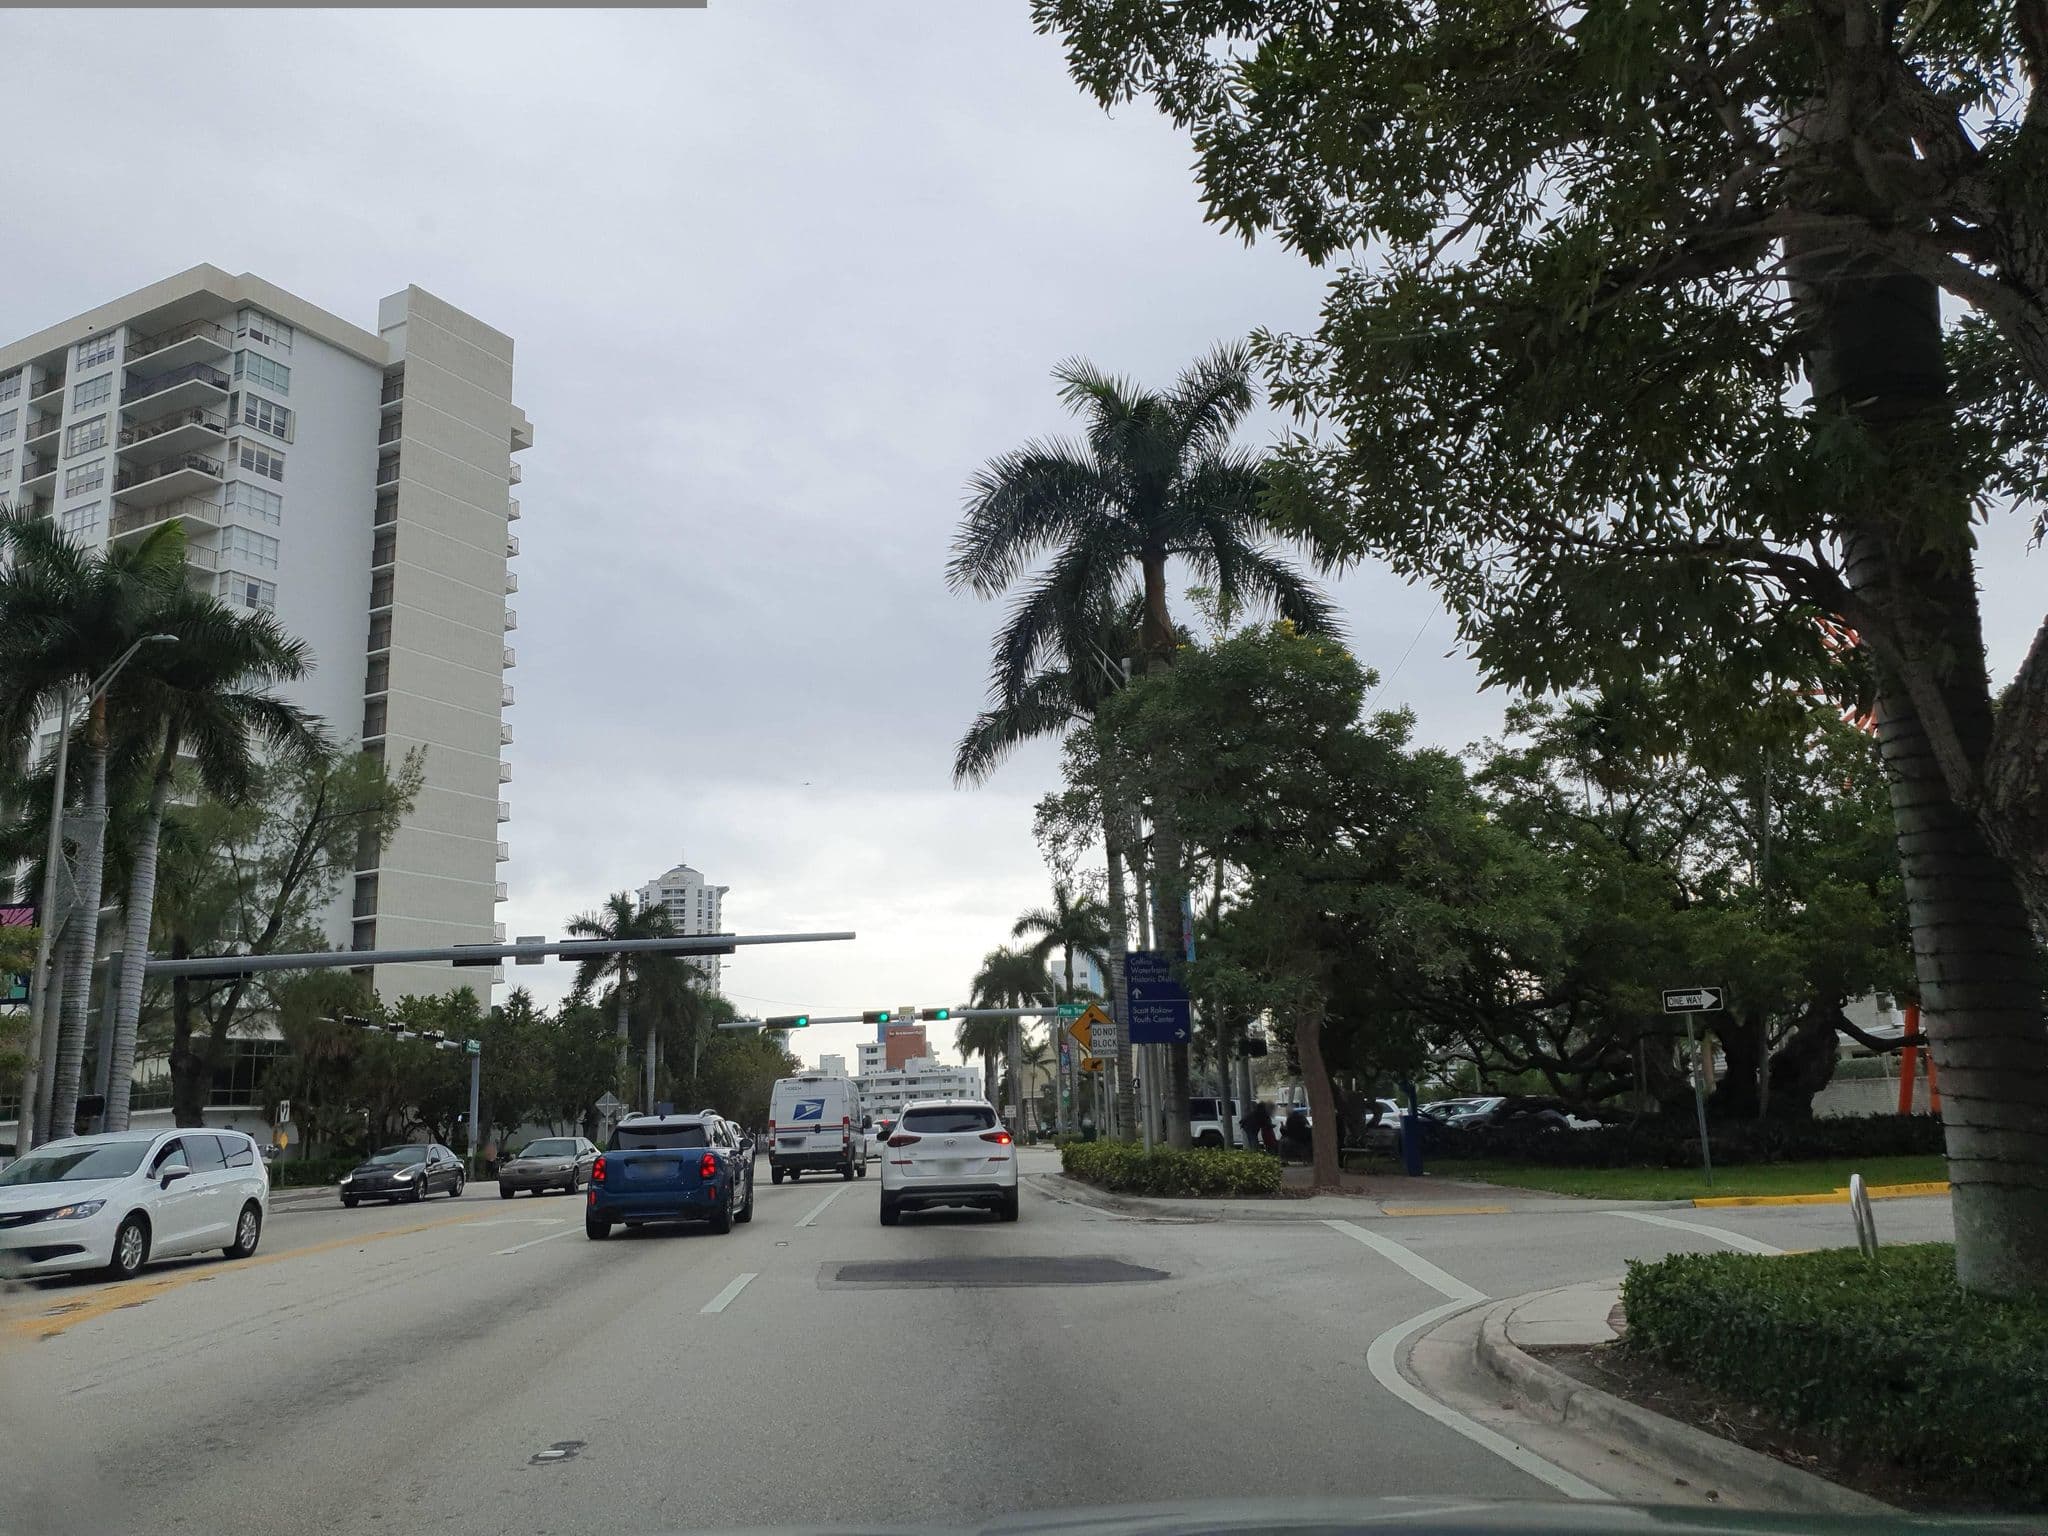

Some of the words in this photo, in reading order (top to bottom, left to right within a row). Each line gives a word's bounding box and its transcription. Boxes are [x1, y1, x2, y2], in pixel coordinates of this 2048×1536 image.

[1130, 957, 1152, 965] Collins
[1130, 966, 1168, 974] Waterfront
[1131, 975, 1157, 983] Historic
[1669, 996, 1684, 1005] ONE
[1686, 995, 1702, 1004] WAY
[1060, 1007, 1072, 1015] Pine
[1132, 1006, 1149, 1014] Scott
[1150, 1006, 1174, 1014] Rokow
[1132, 1015, 1151, 1023] Youth
[1152, 1015, 1175, 1023] Center
[1092, 1028, 1101, 1036] DO
[1102, 1027, 1118, 1036] NOT
[1093, 1039, 1118, 1048] BLOCK
